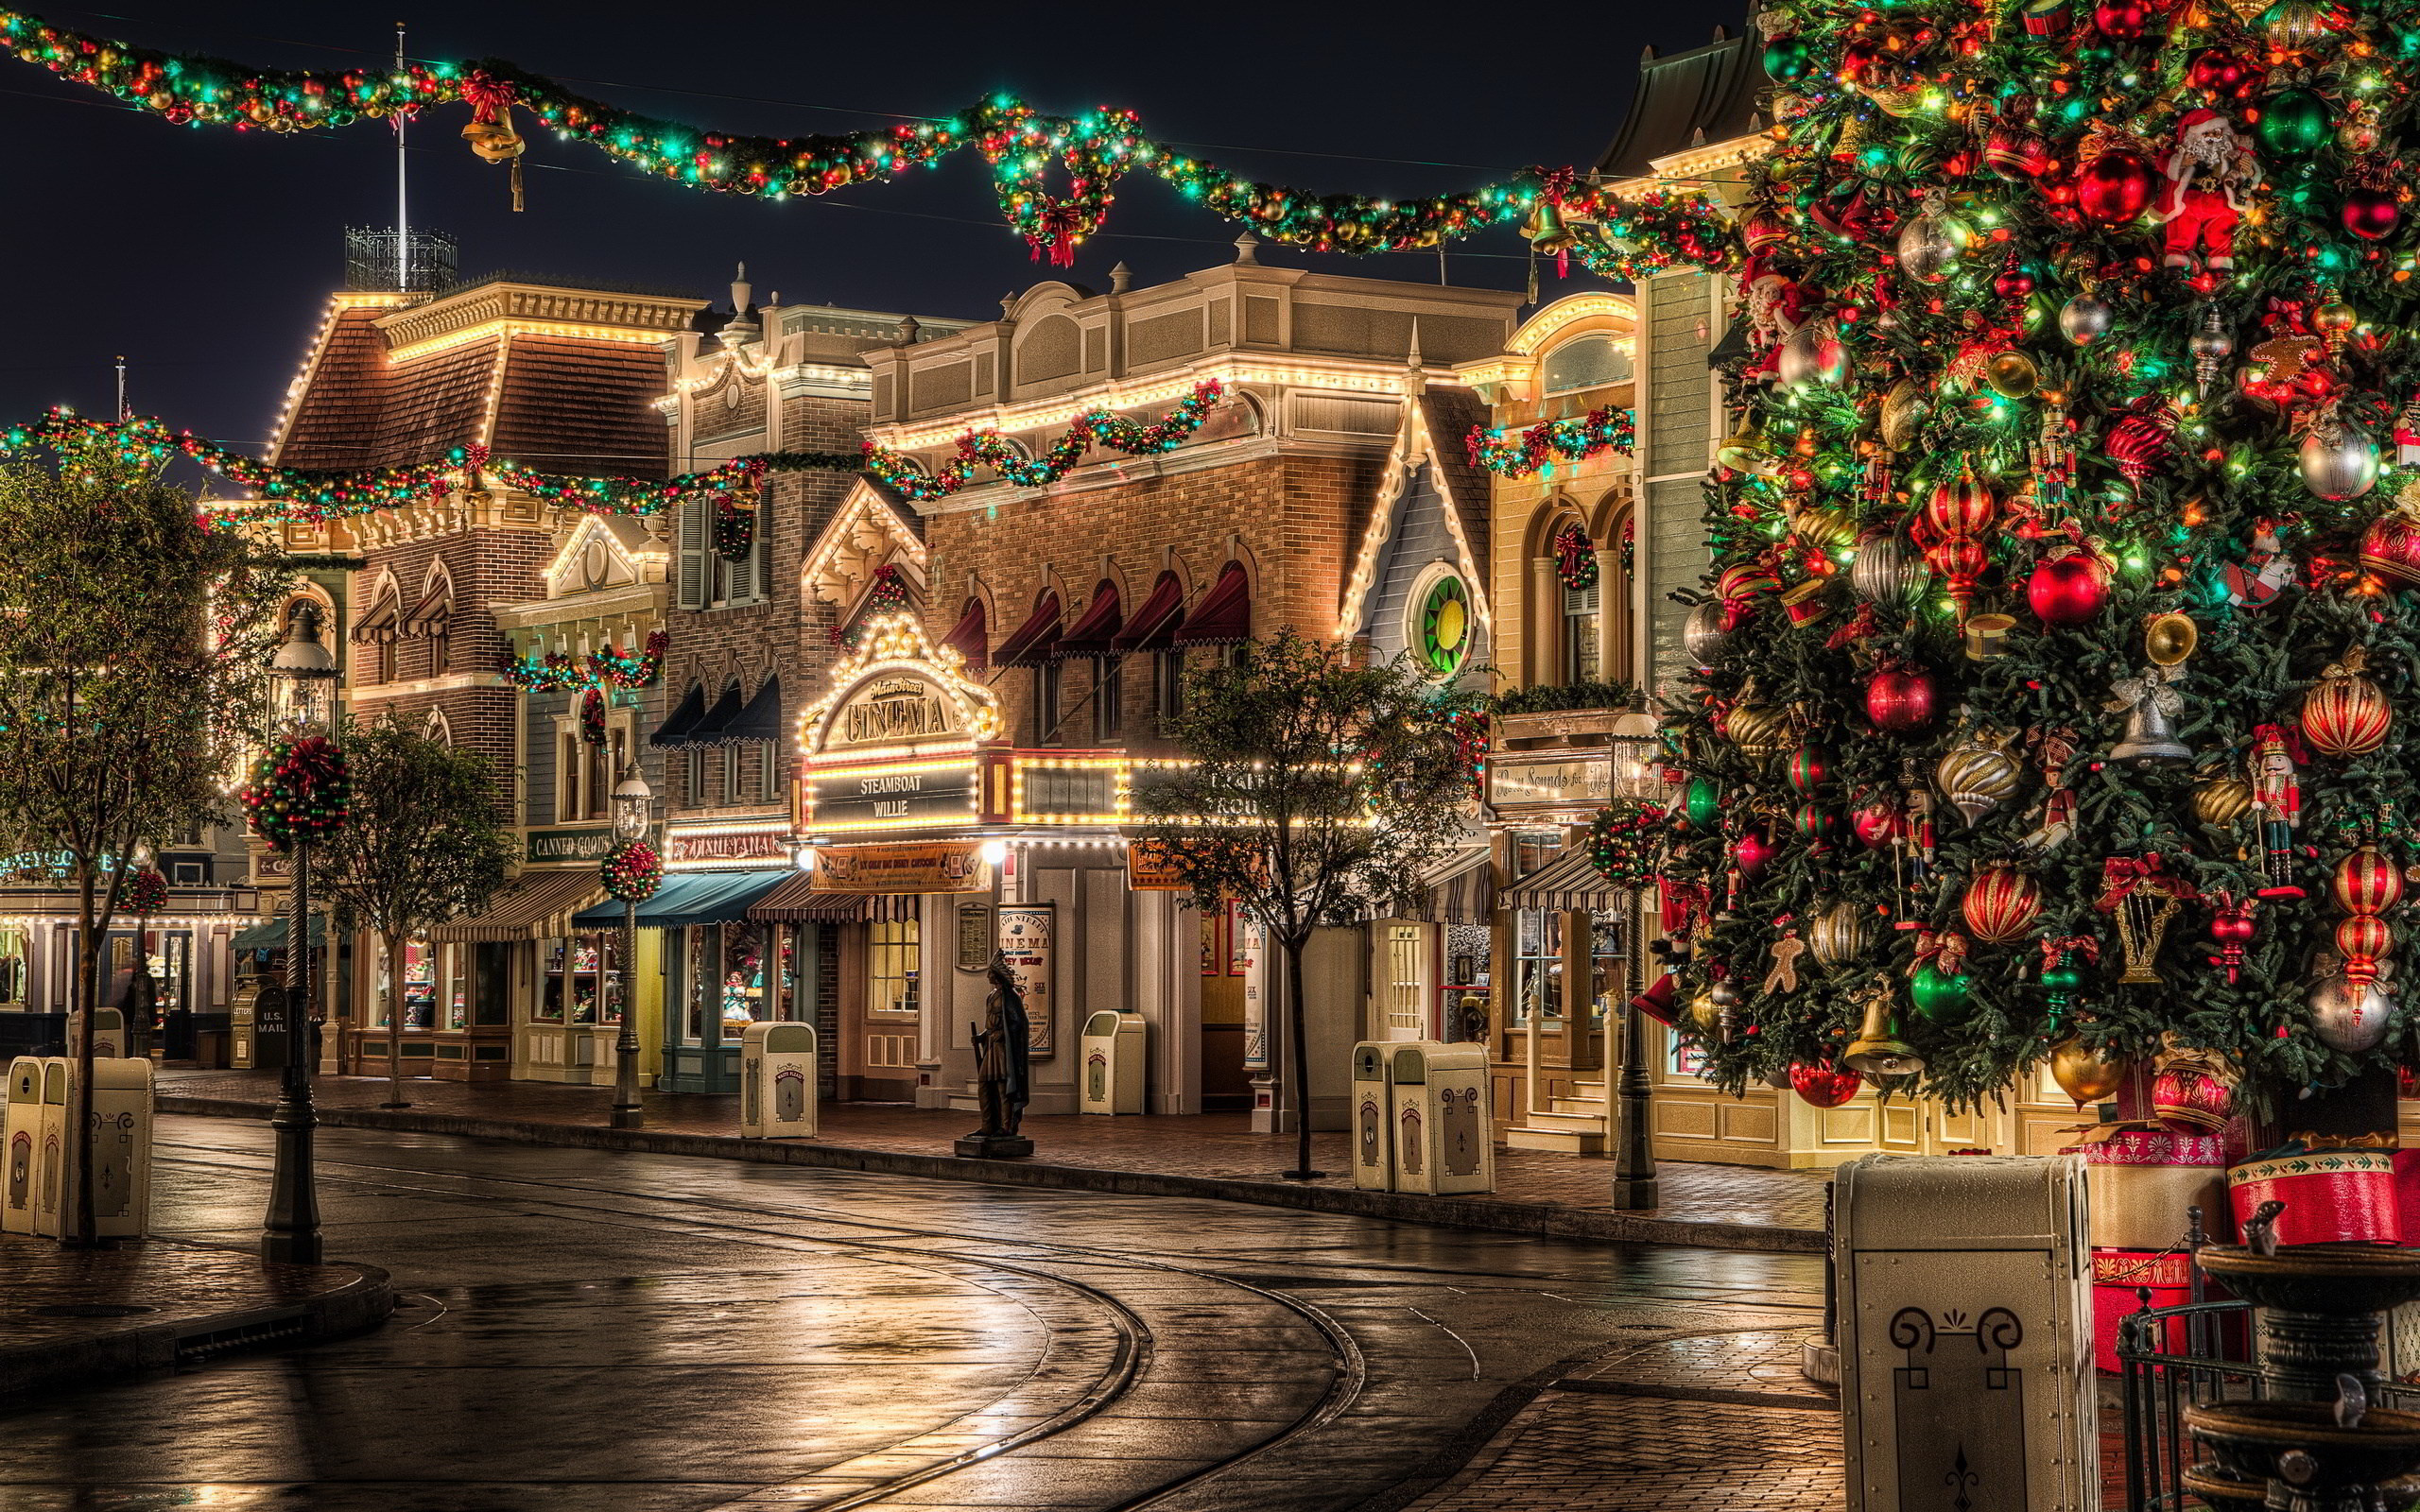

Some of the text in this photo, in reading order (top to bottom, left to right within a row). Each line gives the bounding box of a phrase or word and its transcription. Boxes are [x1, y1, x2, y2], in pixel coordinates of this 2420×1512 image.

[871, 678, 924, 699] Main Street
[845, 696, 947, 742] CINEMA
[860, 775, 922, 795] STEAMBOAT
[1525, 766, 1570, 797] Sounds
[1571, 772, 1582, 787] for
[1589, 764, 1612, 792] Ne
[873, 799, 908, 817] WILLIE
[536, 837, 574, 856] CANNED
[688, 834, 772, 860] DISNEYANA
[1015, 915, 1046, 934] STREET
[999, 937, 1049, 949] INEMA
[264, 1012, 284, 1021] U.S.
[258, 1023, 287, 1033] MAIL
